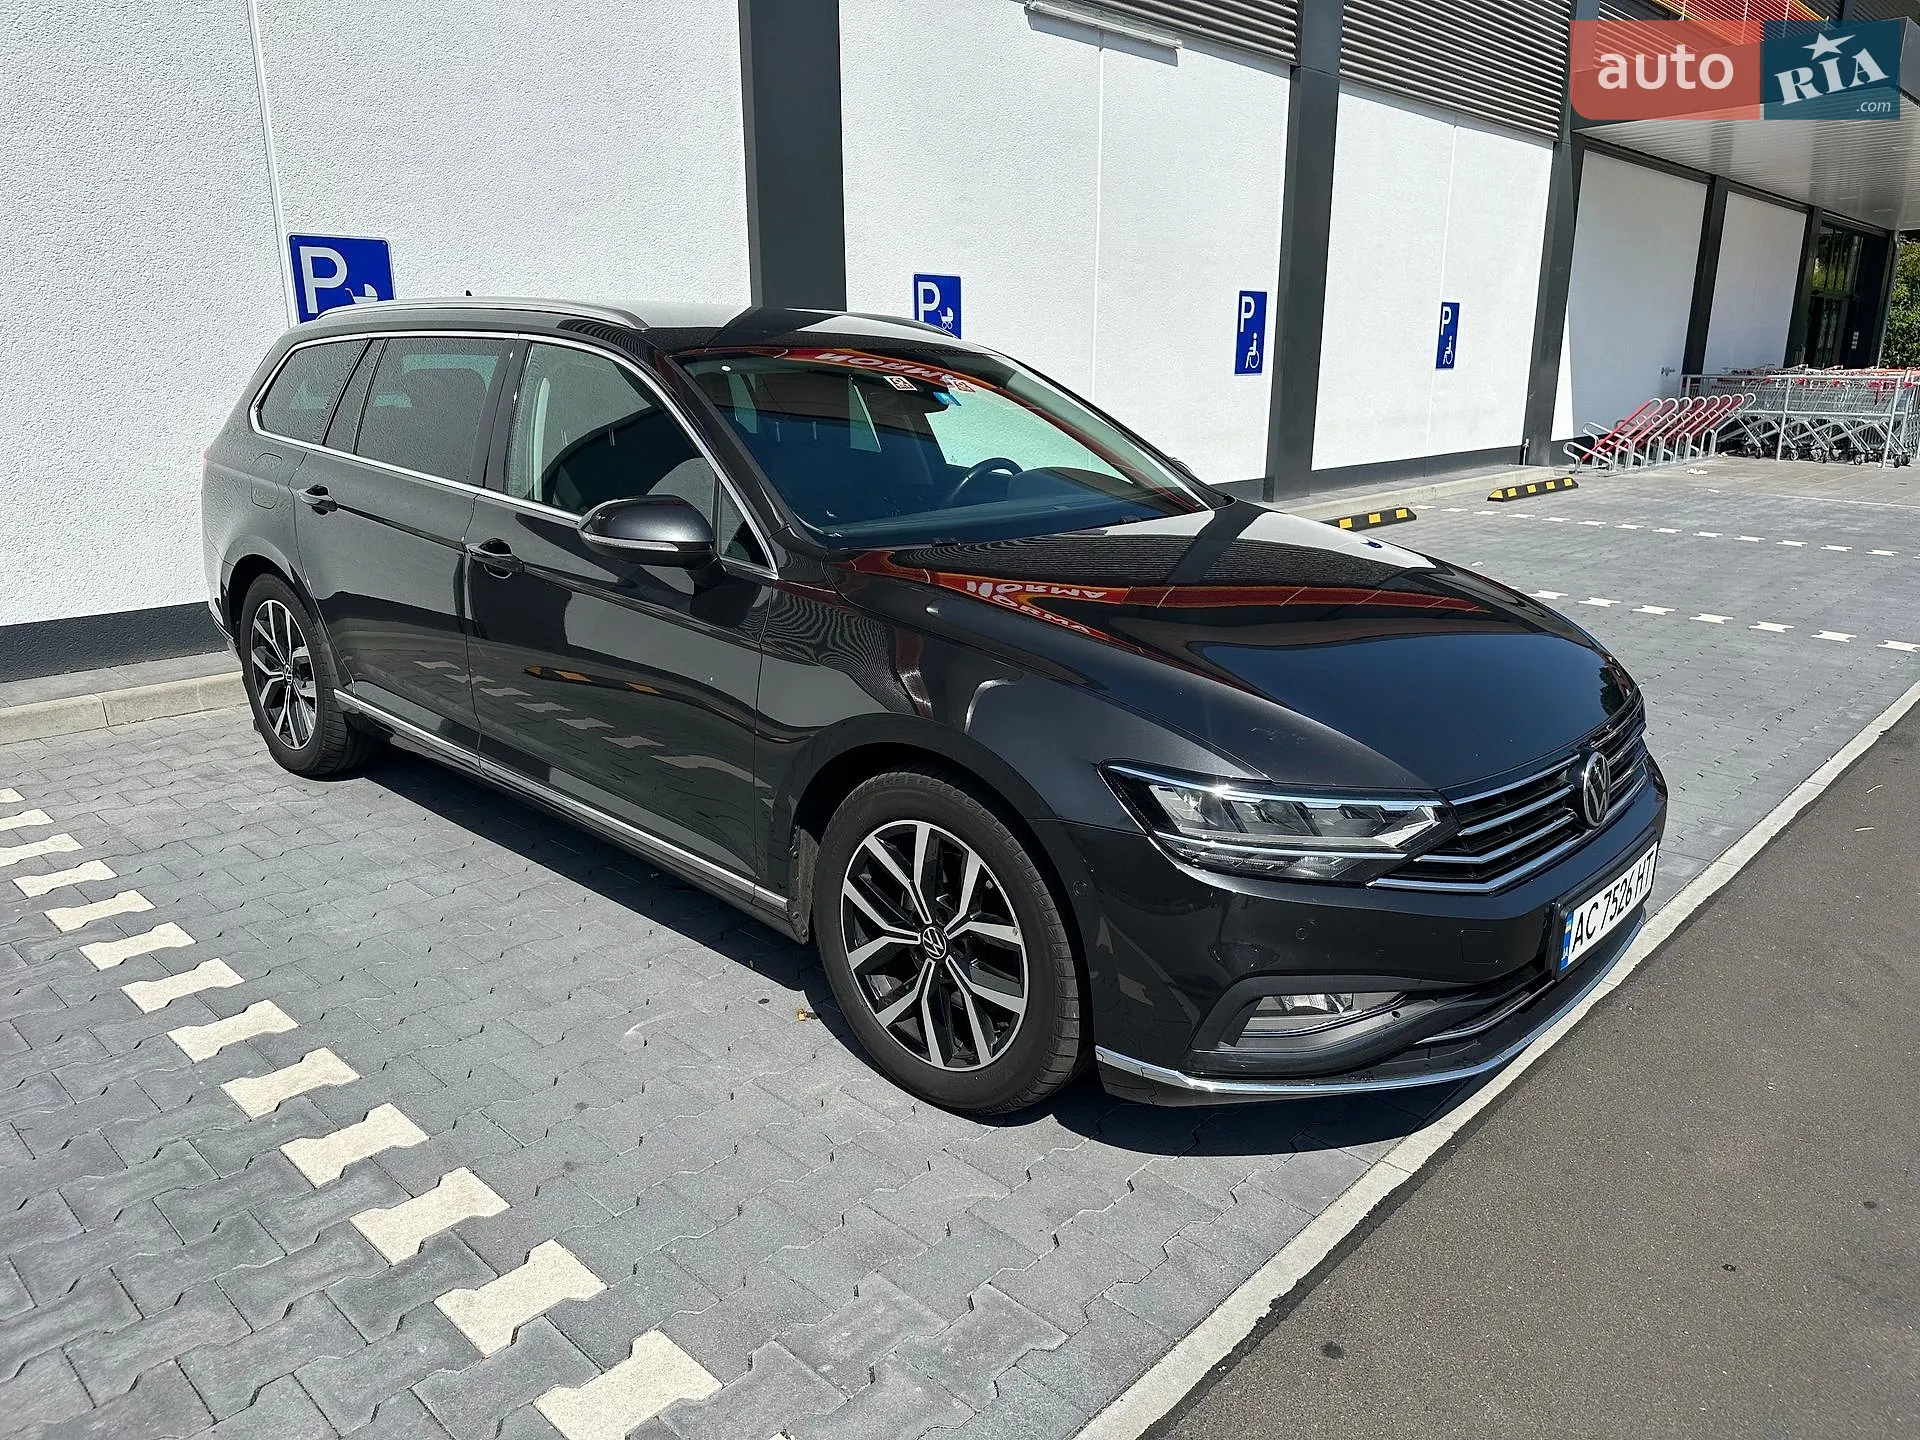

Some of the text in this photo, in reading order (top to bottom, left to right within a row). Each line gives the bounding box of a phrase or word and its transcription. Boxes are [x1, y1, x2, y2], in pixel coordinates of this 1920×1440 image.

[299, 246, 348, 314] P
[918, 281, 941, 322] P
[1240, 295, 1256, 333] P
[1440, 306, 1452, 336] P
[1571, 850, 1655, 953] AC 7526 HT
